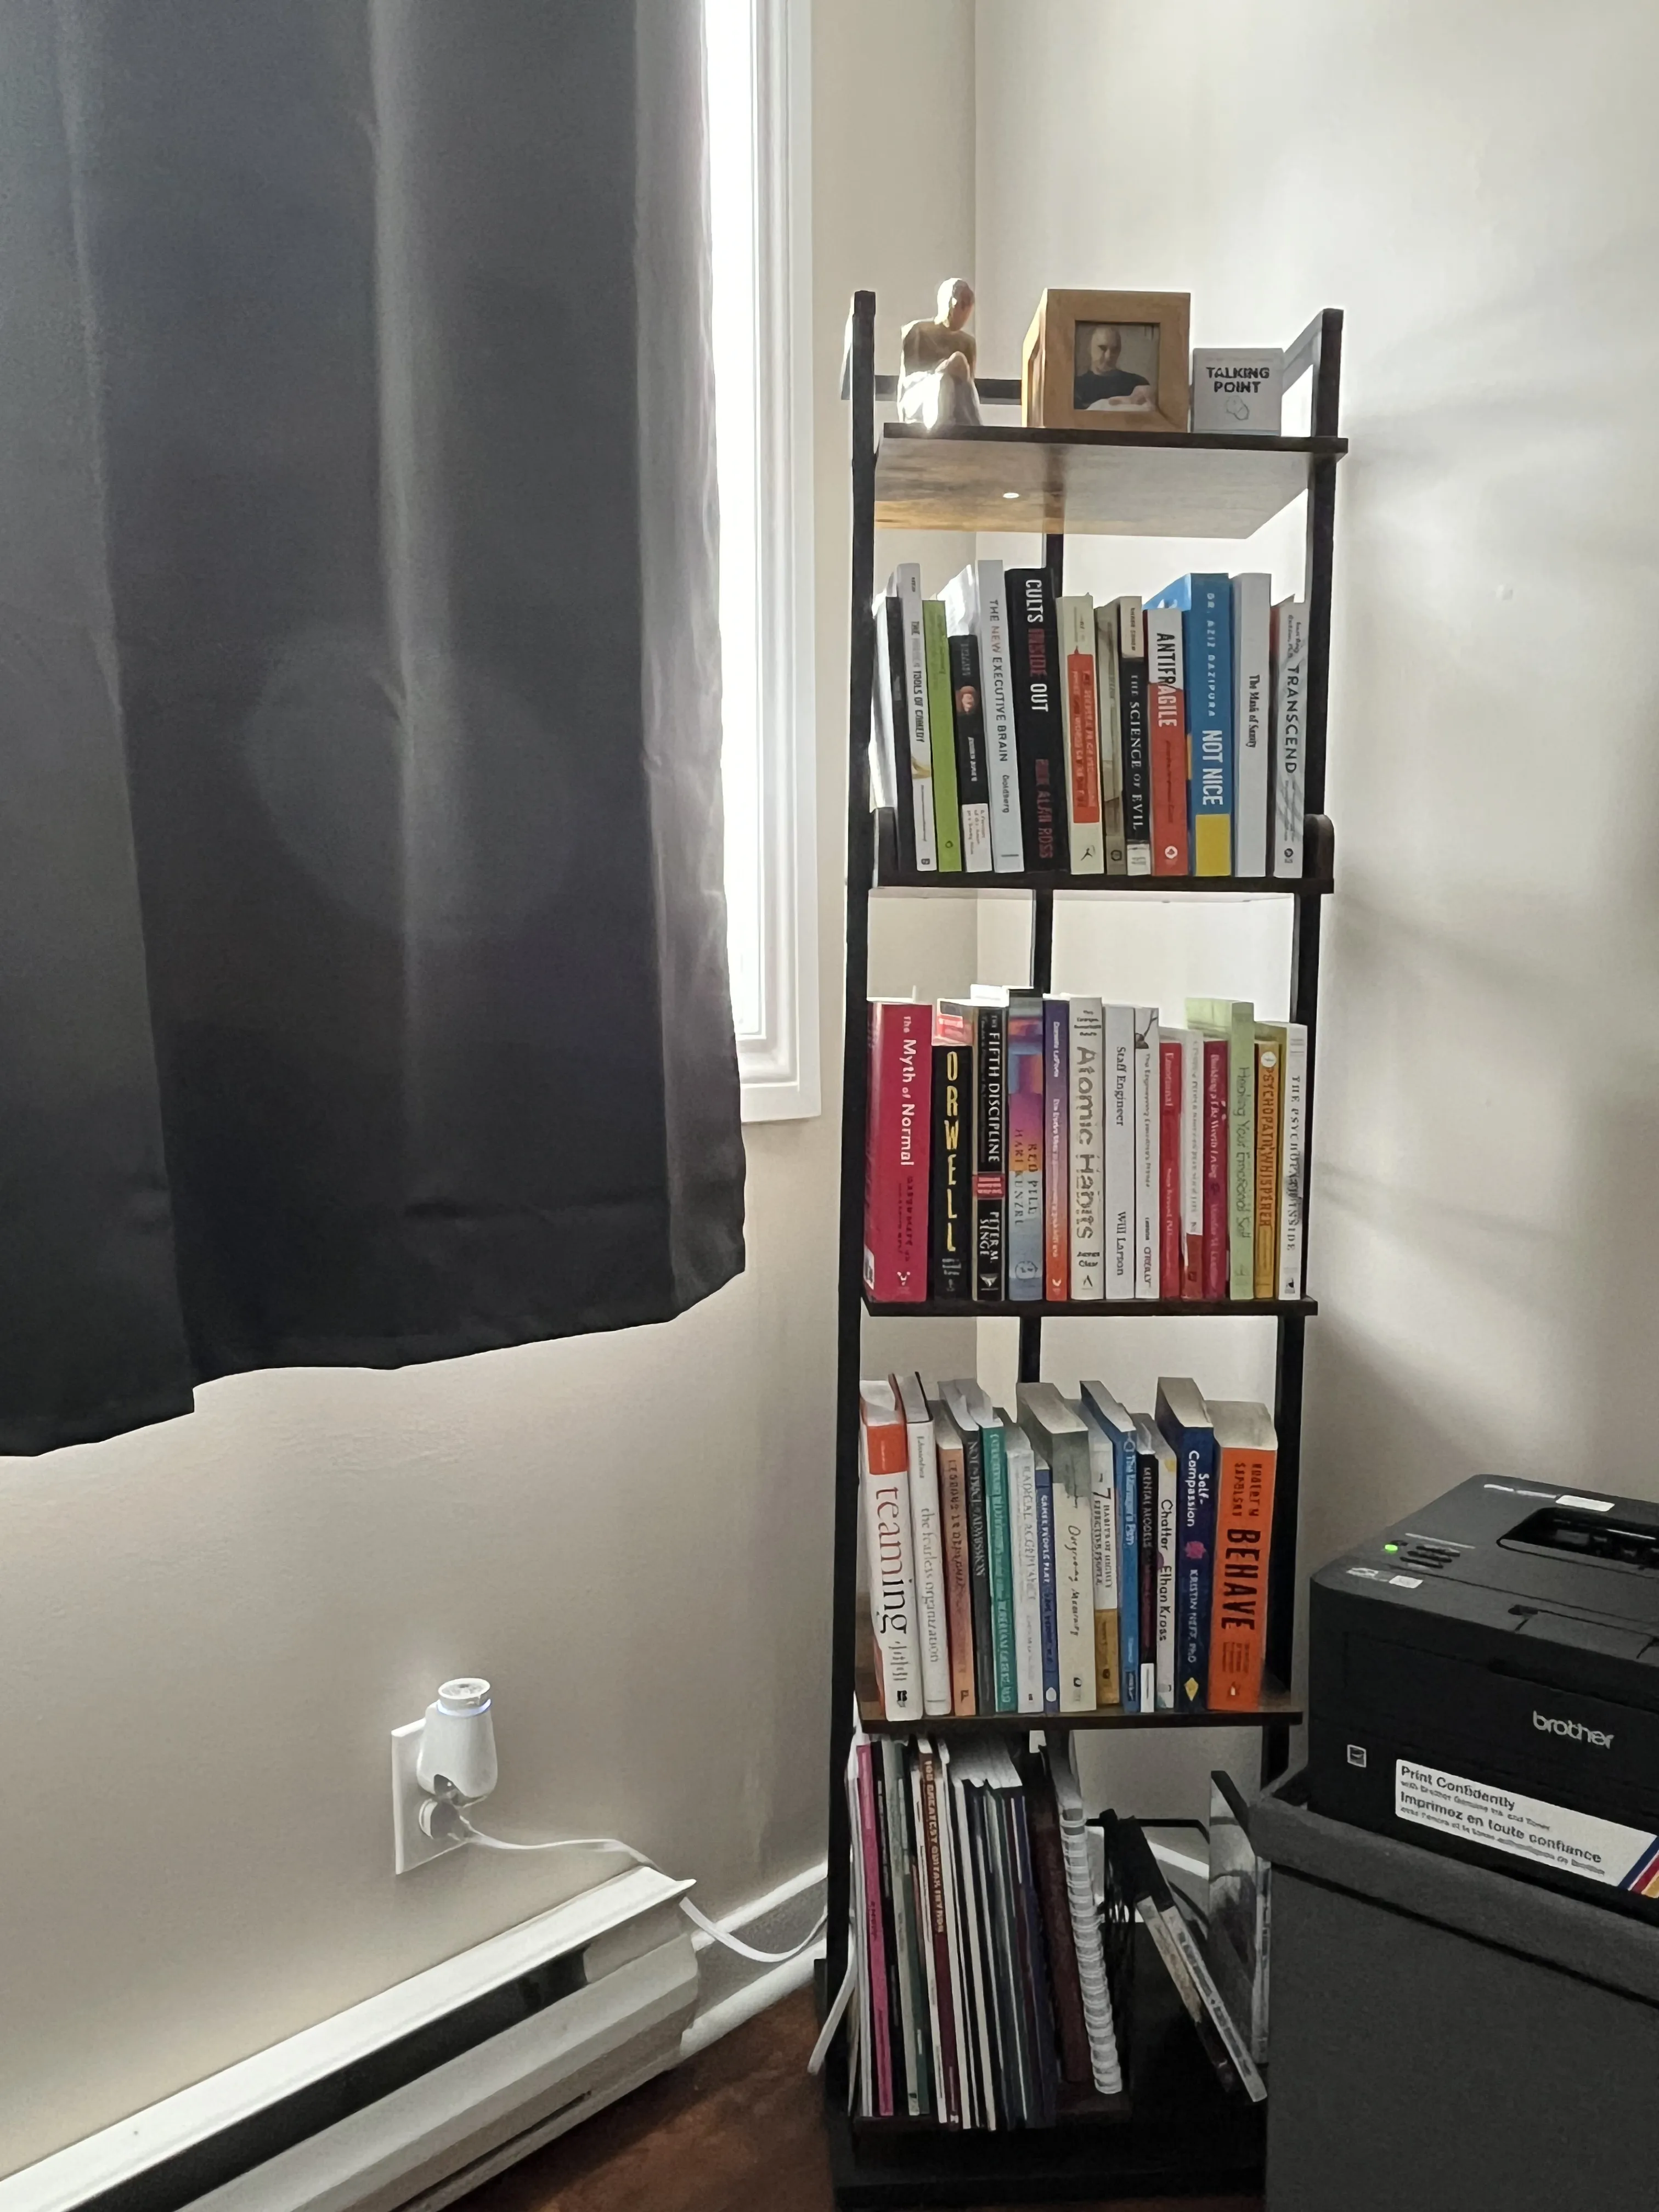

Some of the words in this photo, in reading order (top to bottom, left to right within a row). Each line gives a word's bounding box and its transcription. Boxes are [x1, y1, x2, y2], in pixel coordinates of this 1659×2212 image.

[1205, 366, 1270, 379] TALKING
[1214, 381, 1261, 393] POINT
[990, 599, 999, 621] THE
[1025, 579, 1044, 623] CULTS
[991, 625, 1002, 653] NEW
[1028, 628, 1048, 678] INSIDE
[1207, 620, 1216, 648] AZIZ
[992, 657, 1006, 721] EXECUTIVE
[1030, 683, 1048, 712] OUT
[1156, 633, 1177, 727] ANTIFRAGILE
[1207, 654, 1216, 717] GAZIPURA
[1249, 674, 1260, 689] The
[1129, 701, 1142, 769] SCIENCE
[1246, 724, 1259, 748] Sanity
[1249, 714, 1259, 723] of
[1284, 664, 1299, 774] TRANSCEND
[997, 725, 1008, 762] BRAIN
[1201, 730, 1223, 763] NOT
[1001, 775, 1011, 813] Goldberg
[1202, 768, 1223, 805] NICE
[1131, 794, 1144, 831] EVIL
[903, 1016, 912, 1034] The
[900, 1039, 916, 1082] Myth
[989, 1032, 1000, 1077] FIFTH
[1116, 1046, 1127, 1073] Staff
[902, 1086, 911, 1098] of
[1076, 1046, 1098, 1145] Atomic
[1165, 1052, 1174, 1106] Emotional
[1233, 1066, 1251, 1116] Healing
[1291, 1075, 1300, 1102] THE
[1114, 1075, 1127, 1126] Engineer
[1262, 1067, 1274, 1147] PSYCHOPATH
[901, 1103, 915, 1165] Normal
[988, 1084, 1000, 1163] DISCIPLINE
[1236, 1119, 1251, 1148] Your
[944, 1051, 959, 1252] ORWELL
[1028, 1143, 1039, 1172] RED
[1076, 1154, 1097, 1240] Habits
[1259, 1151, 1273, 1227] WHISPERER
[980, 1218, 990, 1256] SENGE
[990, 1211, 1000, 1246] PETER
[1117, 1211, 1126, 1234] Will
[1287, 1202, 1299, 1251] INSIDE
[1117, 1238, 1126, 1276] Larson
[1023, 1466, 1034, 1520] RADICAL
[1092, 1487, 1111, 1500] 7
[1143, 1467, 1153, 1504] MENTAL
[1185, 1449, 1200, 1527] Compassion
[1198, 1472, 1210, 1505] Self-
[1232, 1462, 1246, 1516] SAPOLSKY
[1249, 1463, 1262, 1506] ROBERT
[921, 1508, 935, 1528] the
[1094, 1500, 1102, 1550] EFFECTIVE
[1103, 1504, 1111, 1539] HABITS
[1143, 1507, 1153, 1547] MODELS
[1161, 1499, 1174, 1550] Chatter
[876, 1487, 913, 1634] teaming
[922, 1532, 938, 1579] fearless
[1159, 1565, 1172, 1602] Ethan
[1189, 1569, 1198, 1610] KRISTIN
[1221, 1528, 1261, 1630] BEHAVE
[922, 1582, 940, 1663] organization
[1159, 1606, 1171, 1641] Kross
[1533, 1710, 1615, 1750] brother
[1401, 1765, 1432, 1785] Print
[1436, 1776, 1515, 1811] Confidently
[1401, 1791, 1463, 1821] Imprimez
[1466, 1814, 1484, 1827] en
[1488, 1819, 1525, 1839] toute
[1528, 1834, 1602, 1864] confiance
